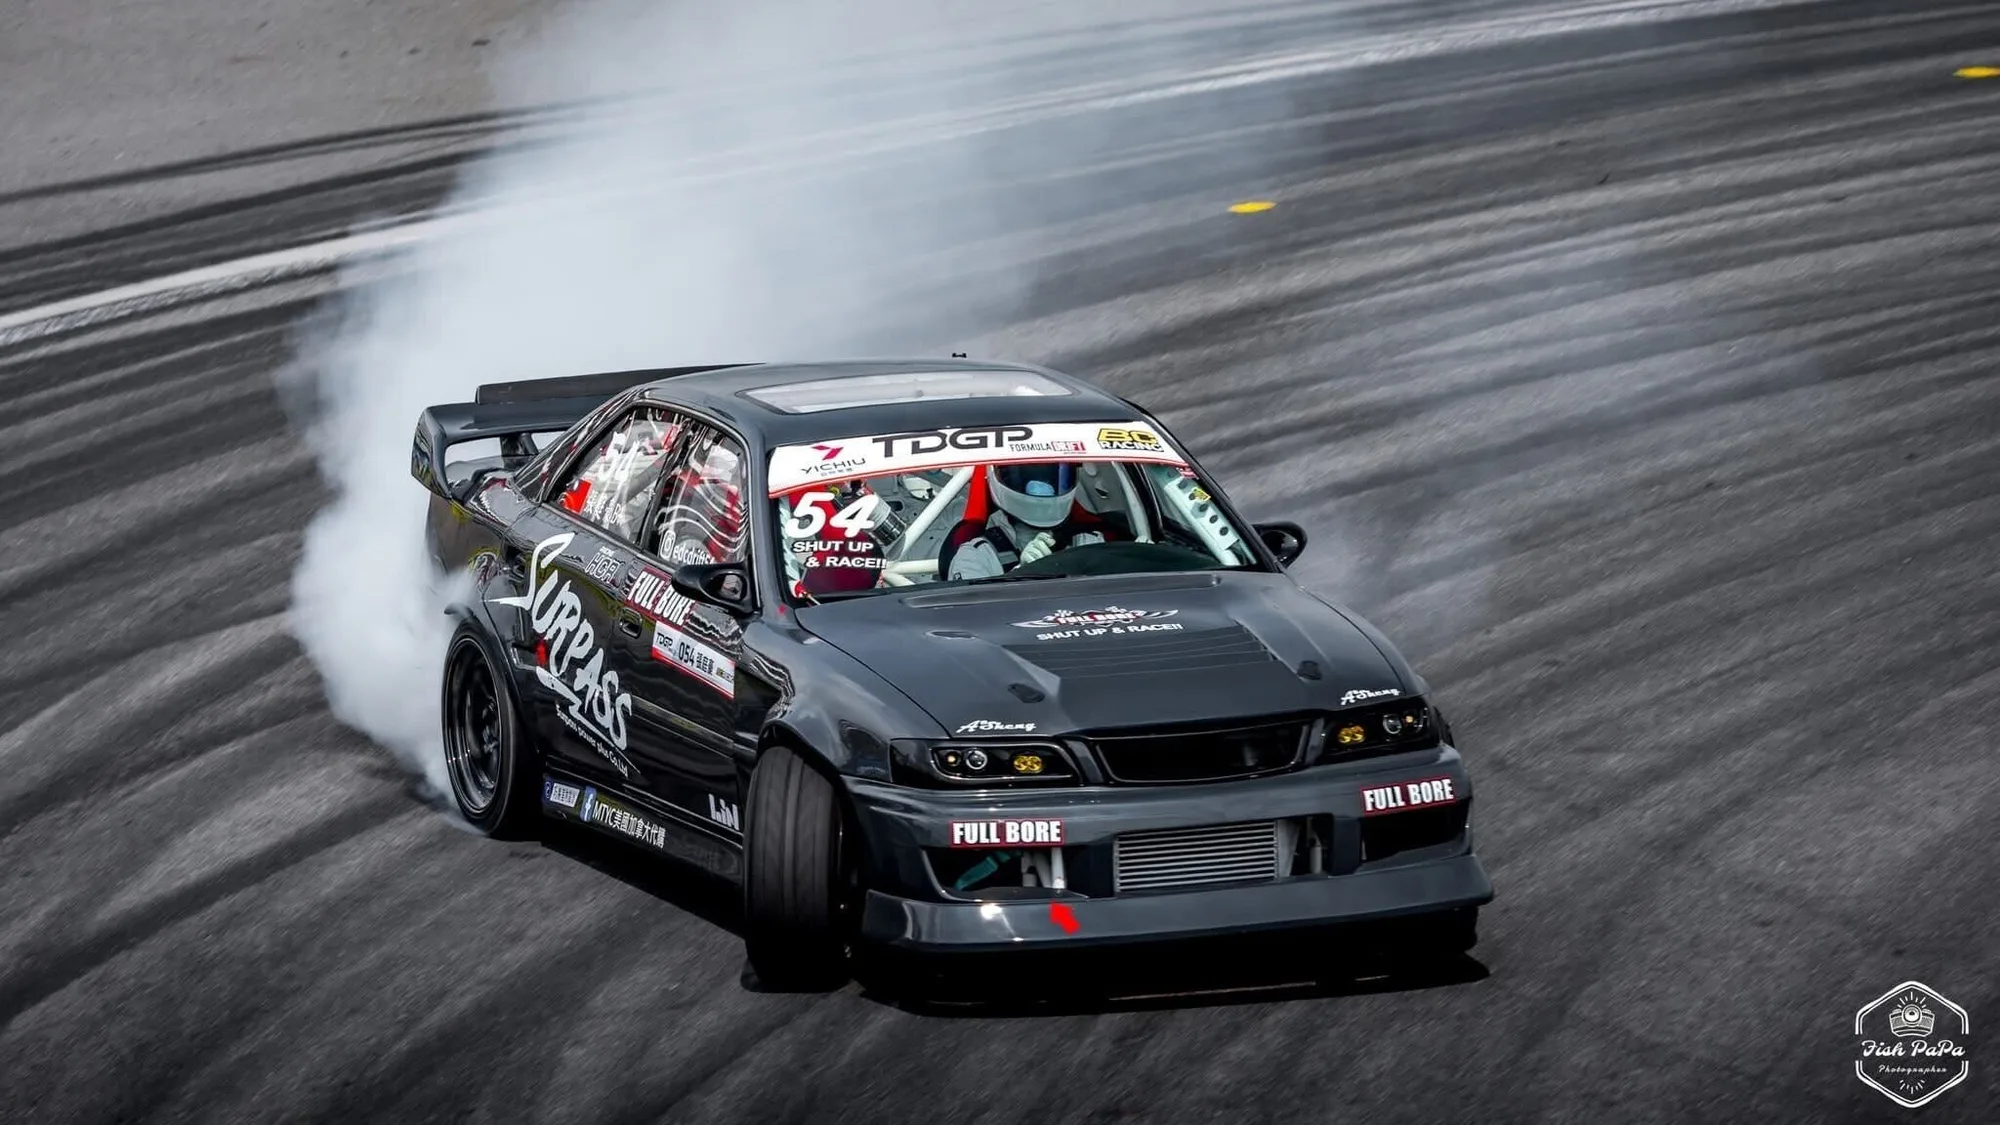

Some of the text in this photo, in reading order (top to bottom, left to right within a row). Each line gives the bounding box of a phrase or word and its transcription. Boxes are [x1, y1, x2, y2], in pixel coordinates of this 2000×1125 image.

[872, 426, 1034, 458] TDGP
[1098, 428, 1156, 443] BC
[1009, 442, 1051, 452] FORMULA
[1101, 440, 1164, 452] RACING
[801, 457, 866, 475] YICHIU
[785, 491, 880, 539] 54
[792, 541, 874, 552] SHUT UP
[805, 556, 889, 569] & RACE!!
[627, 570, 696, 626] FULL BORE
[1036, 622, 1184, 641] SHUT UP & RACE!!
[678, 642, 695, 667] 054
[1363, 779, 1454, 811] FULL BORE
[952, 820, 1061, 844] FULL BORE
